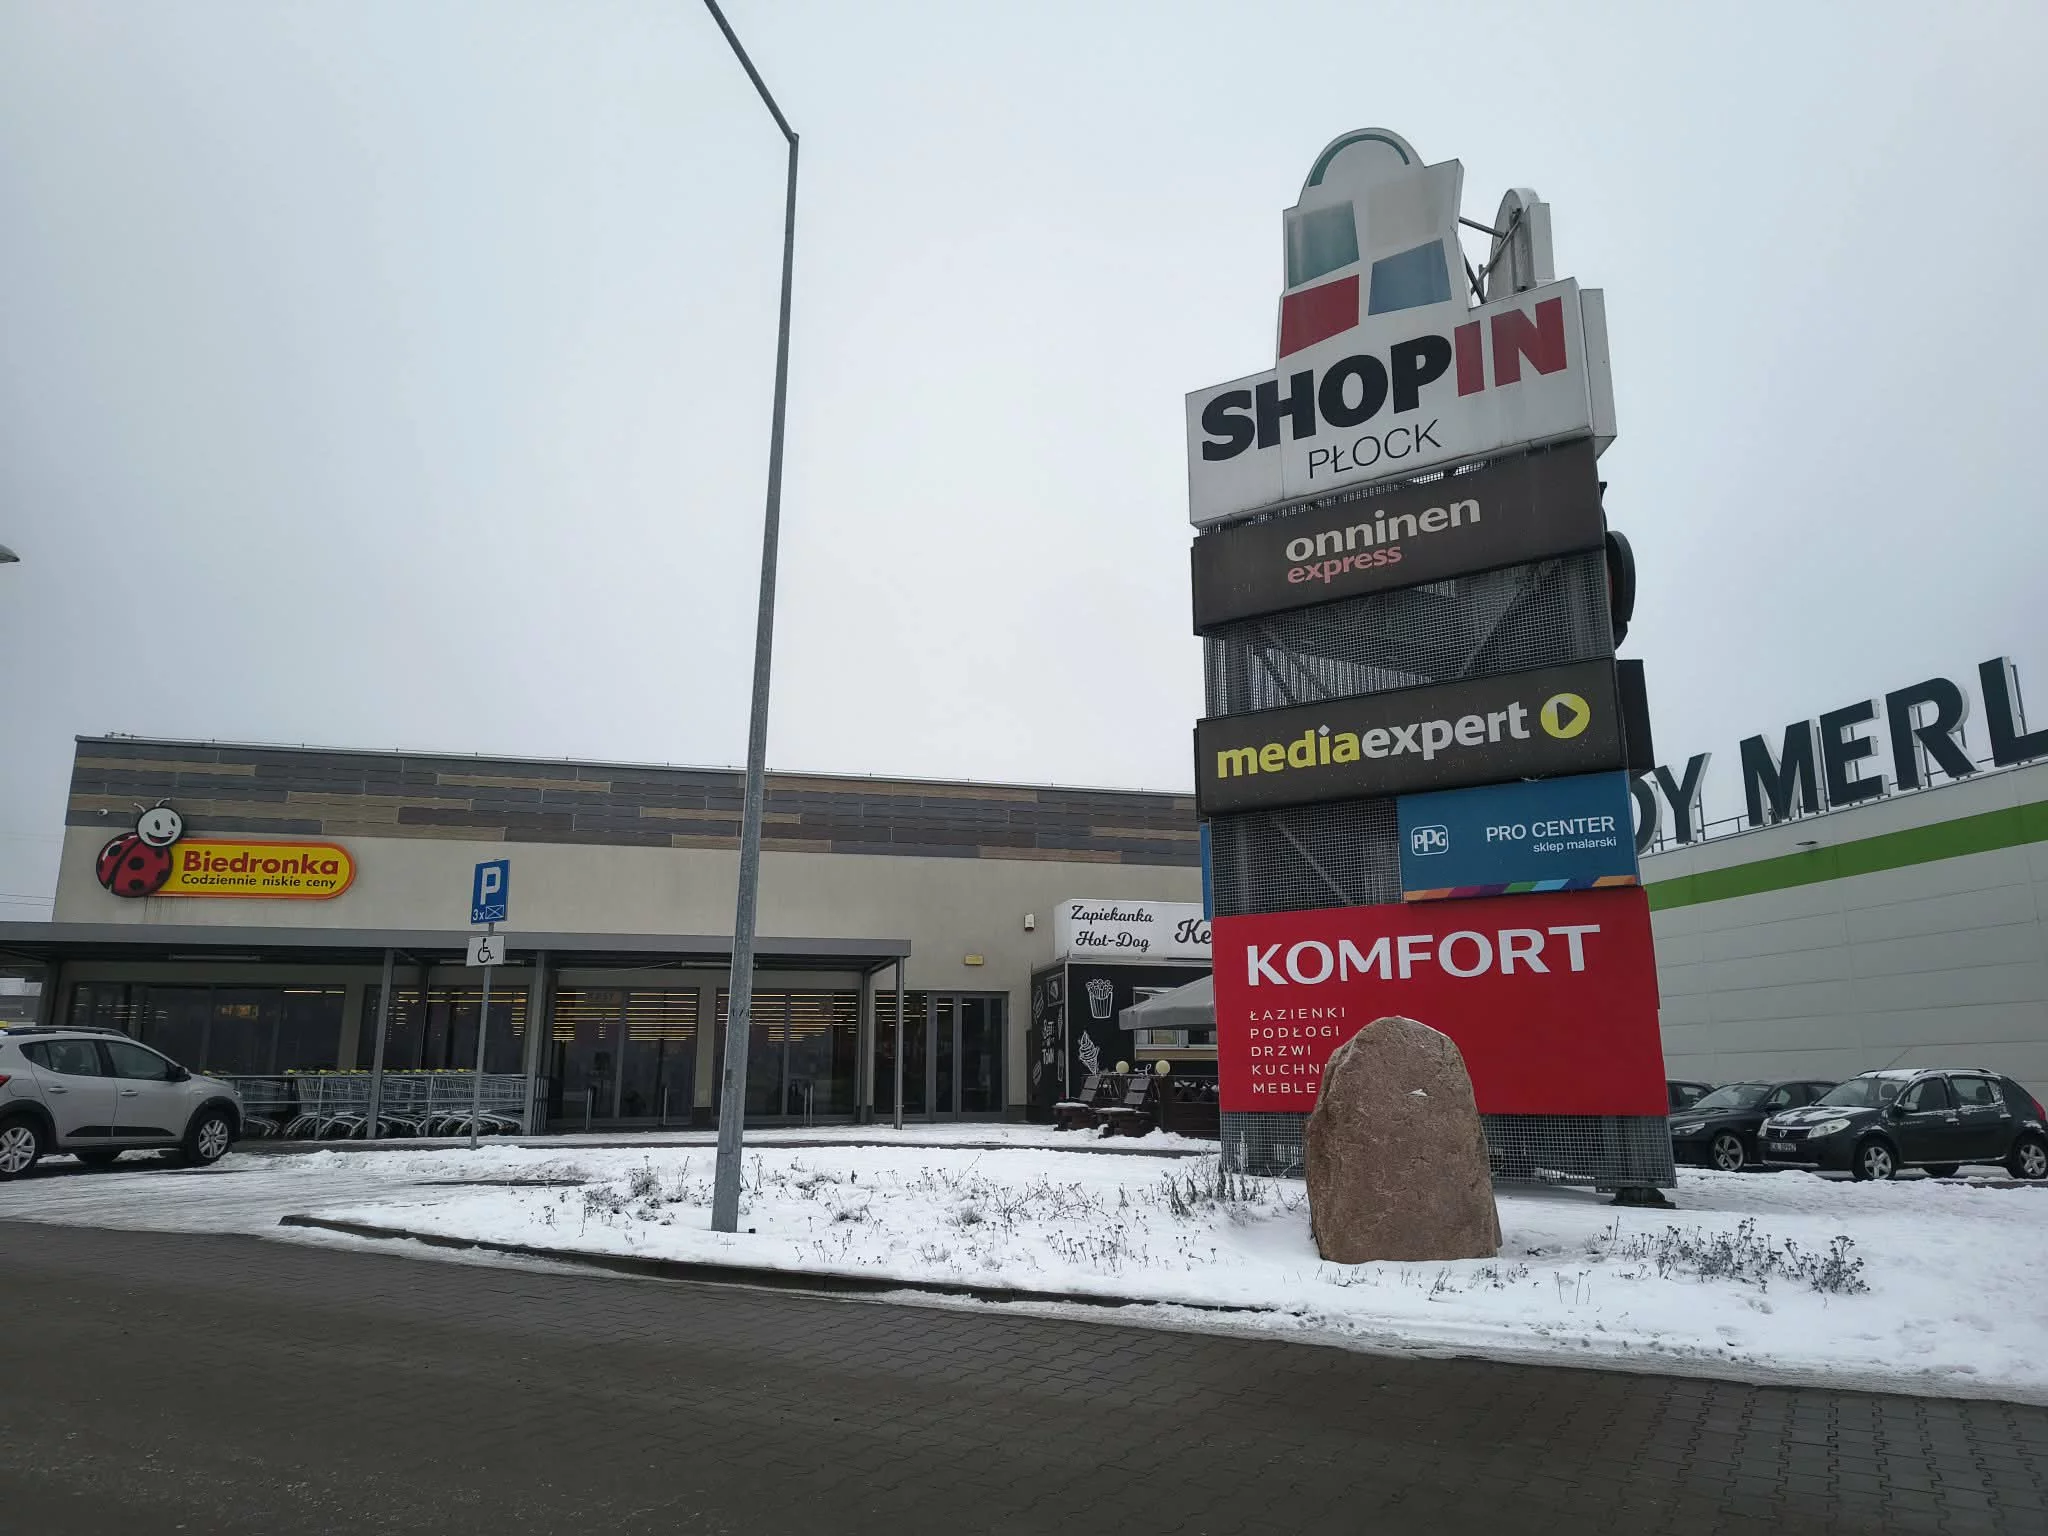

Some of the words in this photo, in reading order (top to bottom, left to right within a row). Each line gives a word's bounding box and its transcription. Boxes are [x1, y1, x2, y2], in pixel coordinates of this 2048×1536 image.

[1201, 296, 1567, 462] SHOPIN
[1308, 418, 1442, 479] PŁOCK
[1286, 498, 1480, 563] onninen
[1287, 546, 1402, 585] express
[1217, 701, 1531, 779] mediaexpert
[1739, 655, 2048, 827] MERL
[1413, 828, 1447, 852] PPG
[1486, 823, 1527, 842] PRO
[1531, 815, 1616, 838] CENTER
[1533, 840, 1564, 854] sklep
[1566, 836, 1617, 851] malarski
[183, 850, 339, 876] Biedronka
[181, 873, 257, 887] Codziennie
[262, 875, 301, 887] niskie
[306, 878, 337, 889] ceny
[480, 866, 501, 905] P
[1070, 904, 1154, 925] Zapiekanka
[1075, 931, 1151, 953] Hot-Dog
[1247, 924, 1600, 986] KOMFORT
[1250, 1007, 1345, 1021] ŁAZIENKI
[1250, 1026, 1339, 1039] PODŁOGI
[1251, 1045, 1311, 1057] DRZWI
[1253, 1082, 1317, 1094] MEBLE
